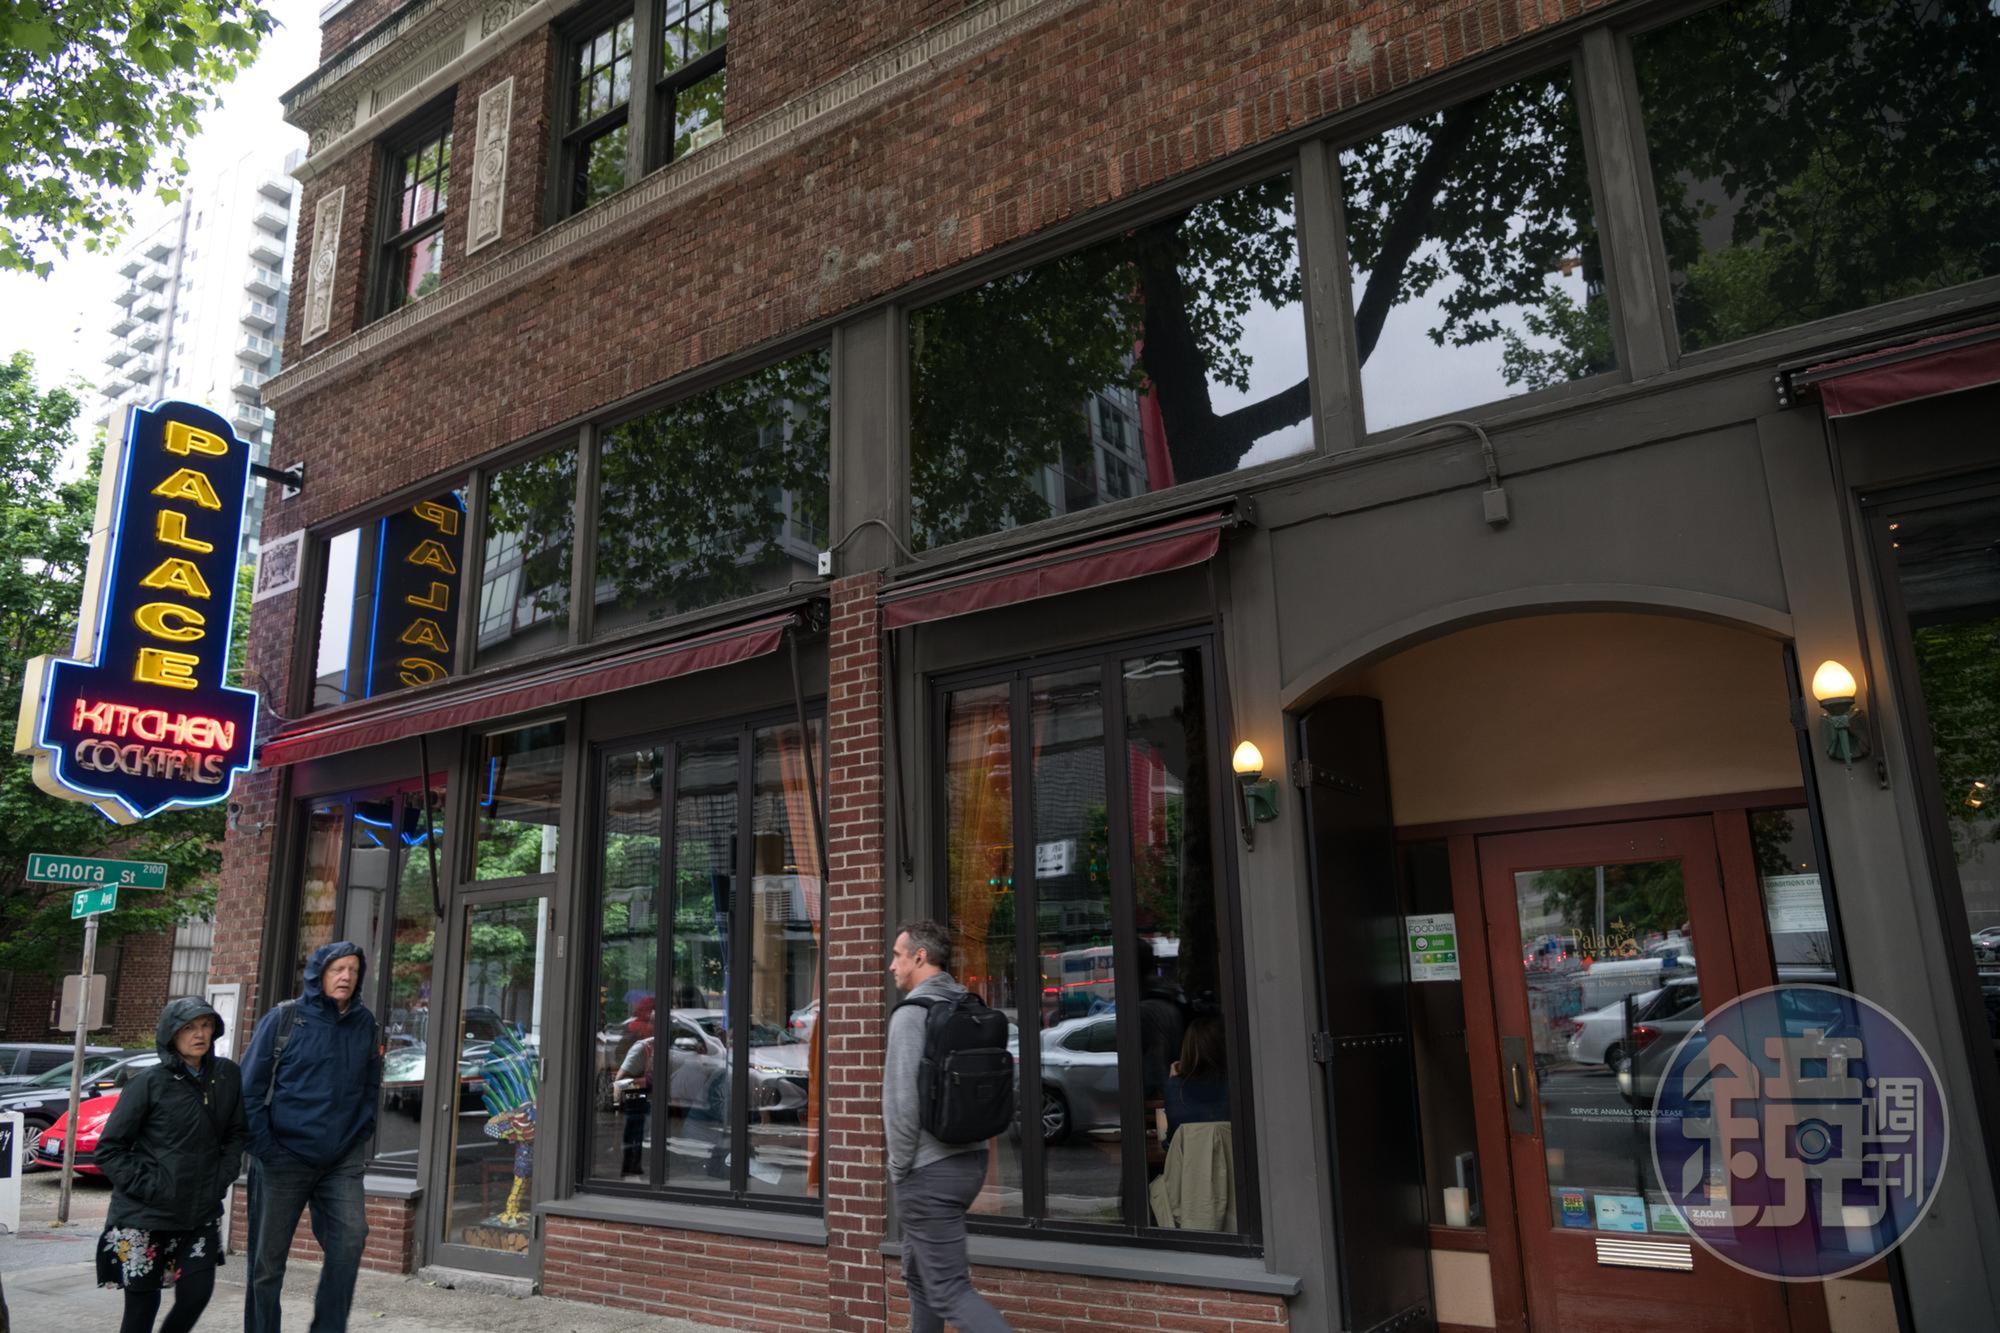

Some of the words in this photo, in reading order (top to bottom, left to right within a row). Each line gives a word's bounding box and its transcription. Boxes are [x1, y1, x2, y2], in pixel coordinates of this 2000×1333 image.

[132, 420, 229, 690] PALACE
[72, 698, 236, 752] KITCHEN
[74, 738, 225, 785] COCKTAILS
[33, 857, 105, 881] Lenora
[120, 869, 136, 884] St
[143, 864, 164, 875] 2100
[1408, 925, 1435, 934] FOOD
[1572, 927, 1624, 950] Palace
[1572, 948, 1638, 957] KITCHEN
[1570, 1107, 1599, 1116] SERVICE
[1600, 1108, 1633, 1117] ANIMALS
[1634, 1109, 1655, 1117] ONLY
[1656, 1109, 1684, 1117] PLEASE
[1692, 1209, 1727, 1219] ZAGAT
